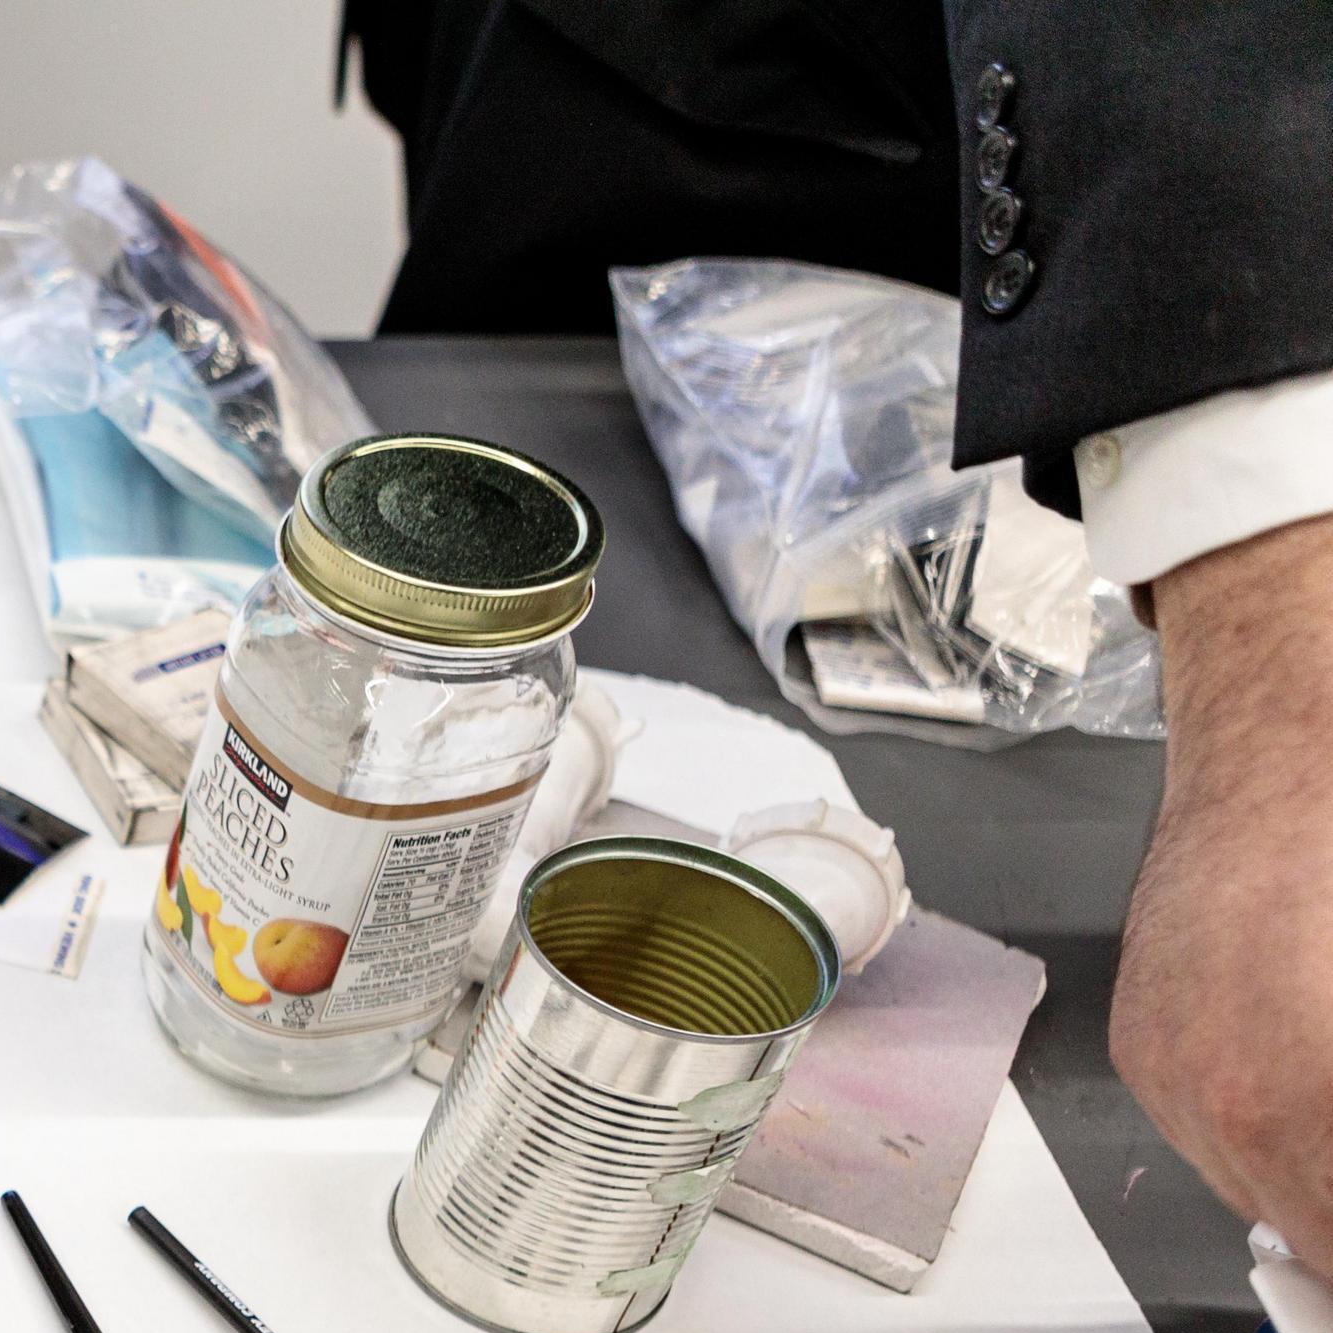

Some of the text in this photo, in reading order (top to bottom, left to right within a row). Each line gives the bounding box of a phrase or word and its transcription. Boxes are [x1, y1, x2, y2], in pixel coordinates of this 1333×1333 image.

[227, 728, 288, 798] KIRKLAND
[197, 769, 295, 885] PEACHES
[210, 753, 288, 848] SLICED
[392, 828, 472, 849] Nutrition Facts
[296, 896, 332, 912] SYRUP
